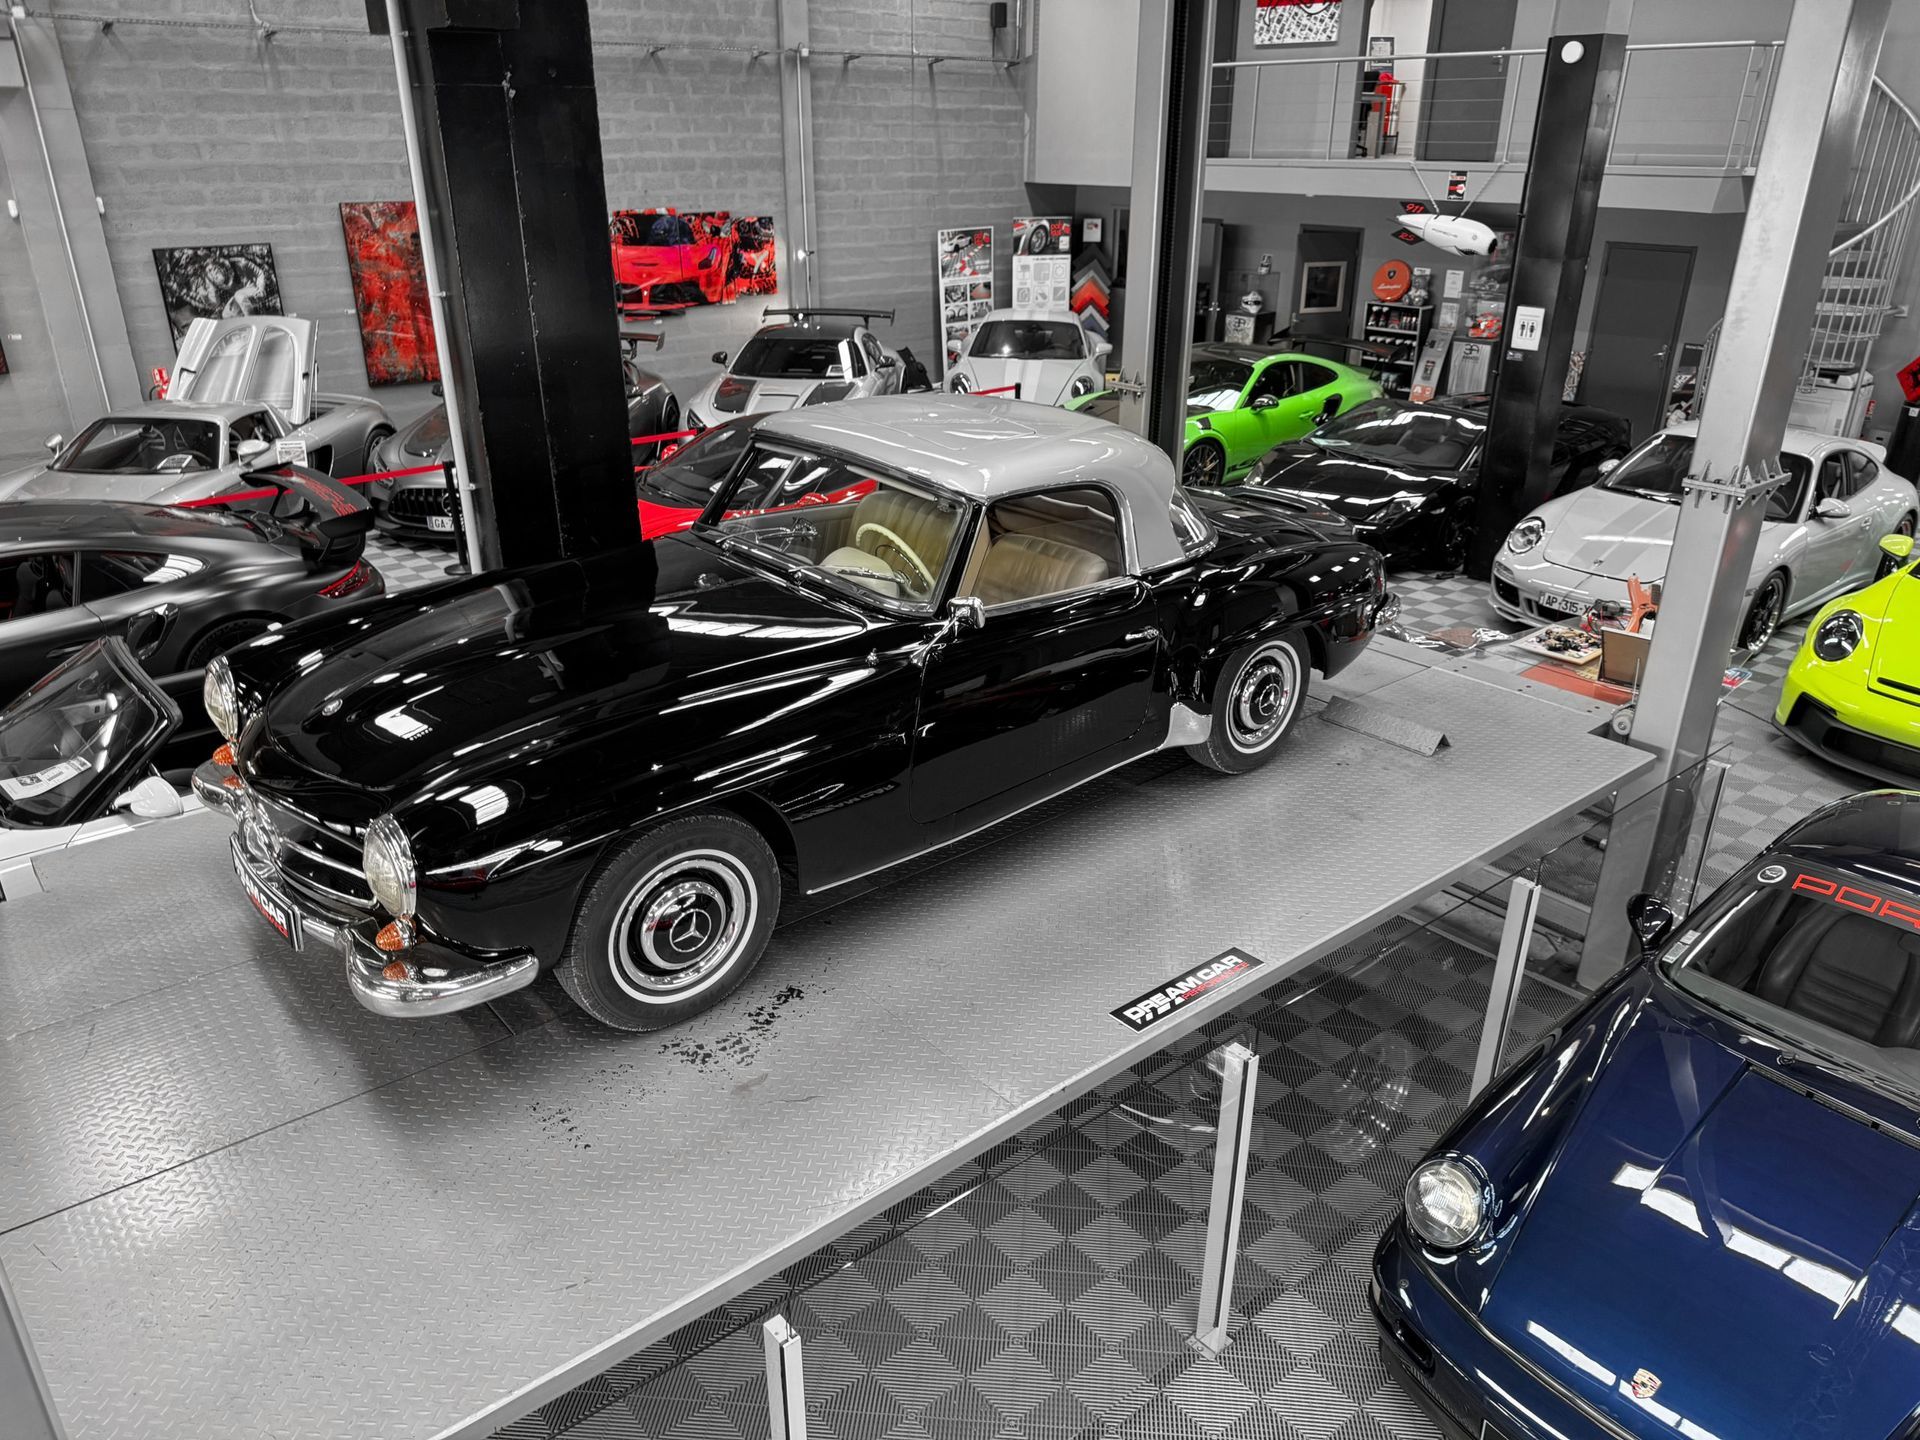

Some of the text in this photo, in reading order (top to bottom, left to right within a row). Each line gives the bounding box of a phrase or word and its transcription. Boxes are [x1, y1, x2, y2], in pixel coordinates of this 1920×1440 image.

[1406, 203, 1425, 213] 911
[260, 893, 288, 930] CAR
[1792, 873, 1920, 930] POR
[1122, 954, 1243, 1021] DREAM CAR
